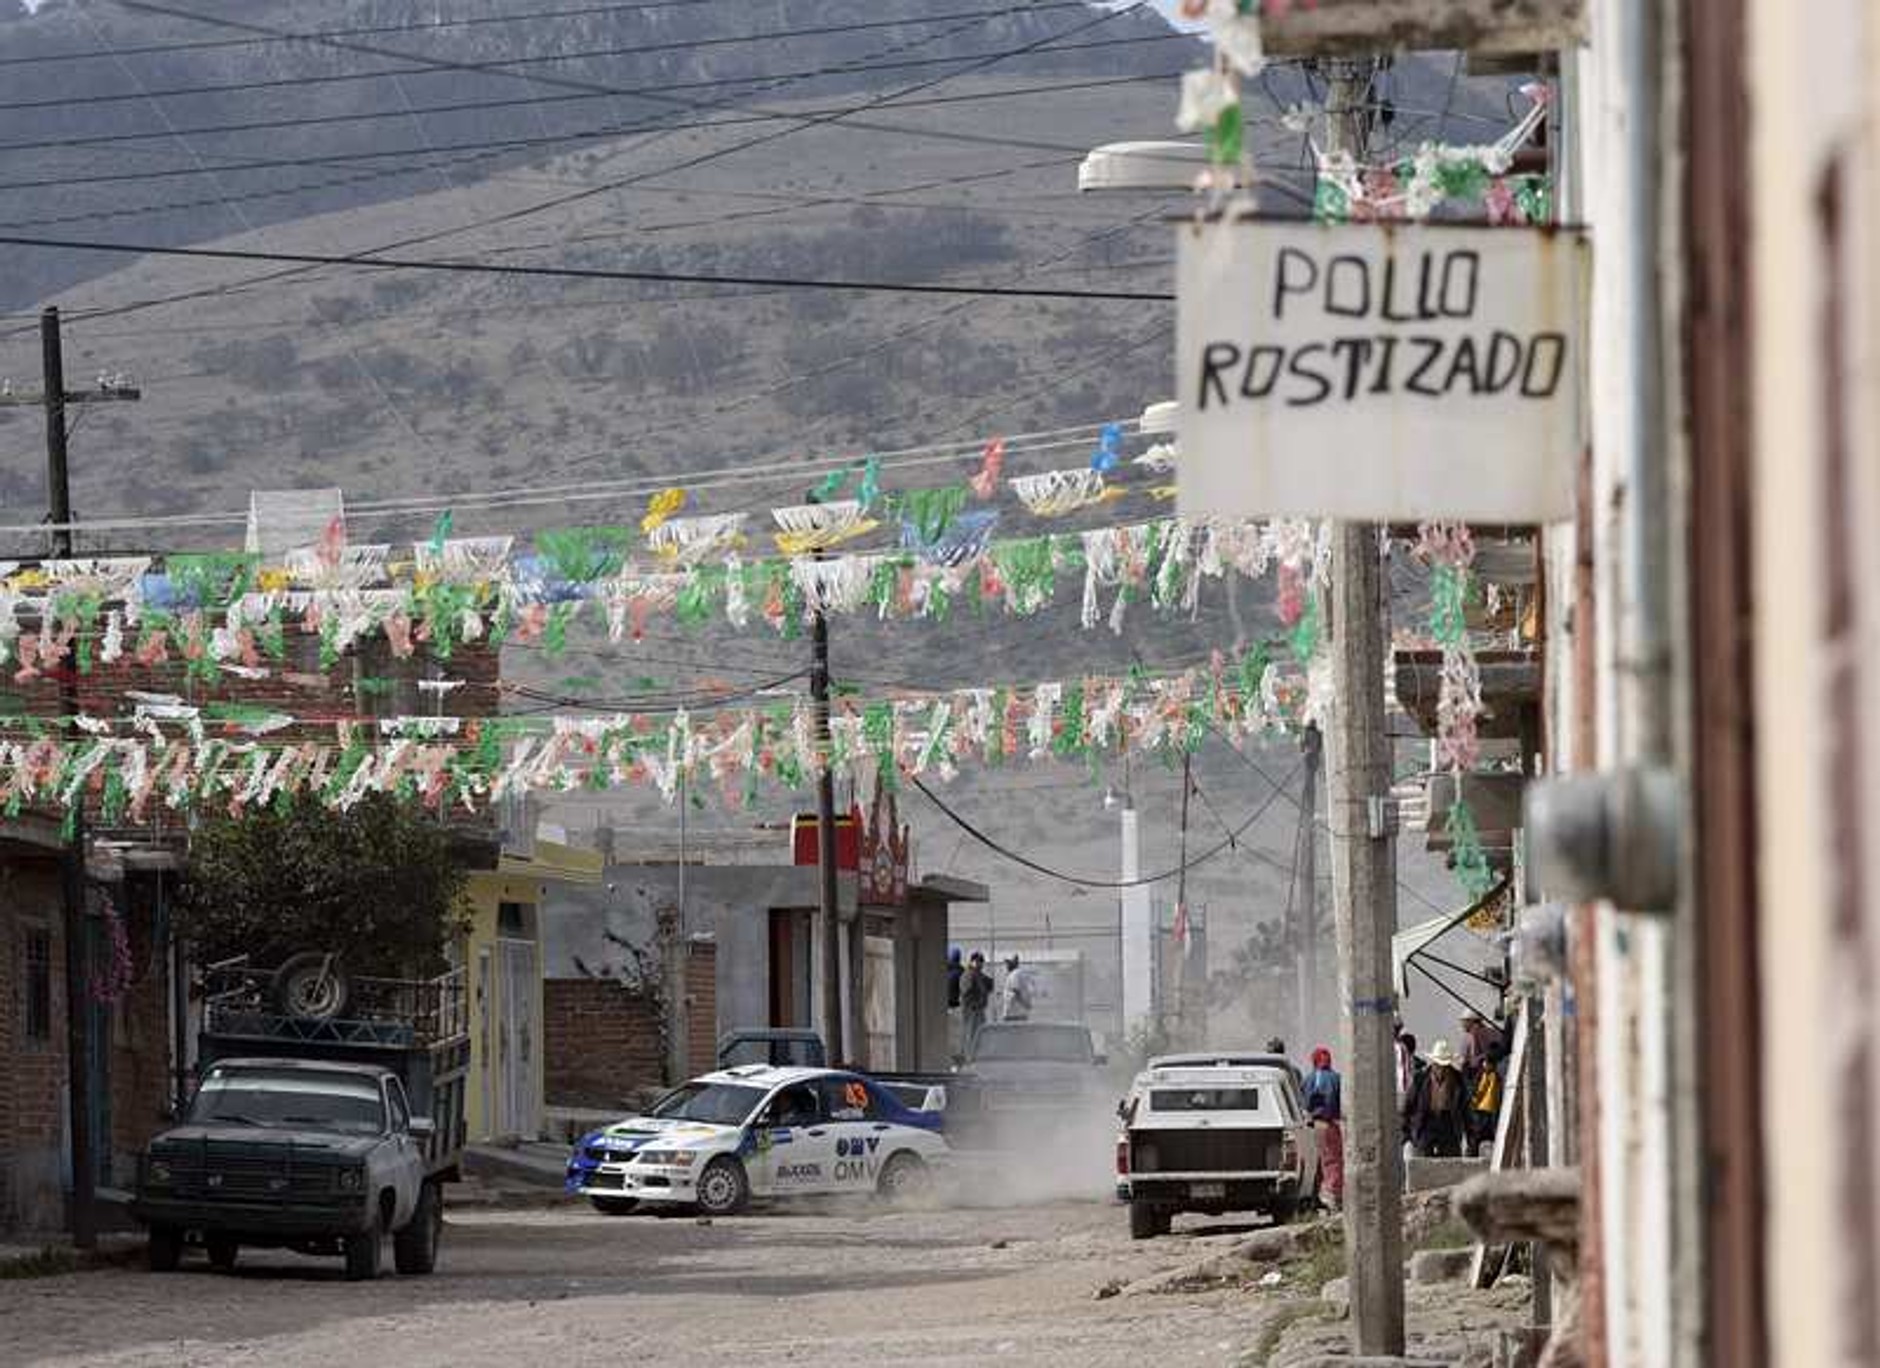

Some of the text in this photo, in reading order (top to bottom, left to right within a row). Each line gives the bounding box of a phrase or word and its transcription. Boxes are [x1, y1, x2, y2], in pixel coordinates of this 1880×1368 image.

[1273, 247, 1479, 321] POLLO
[1198, 330, 1566, 411] ROSTIZADO
[835, 1161, 879, 1180] OMV
